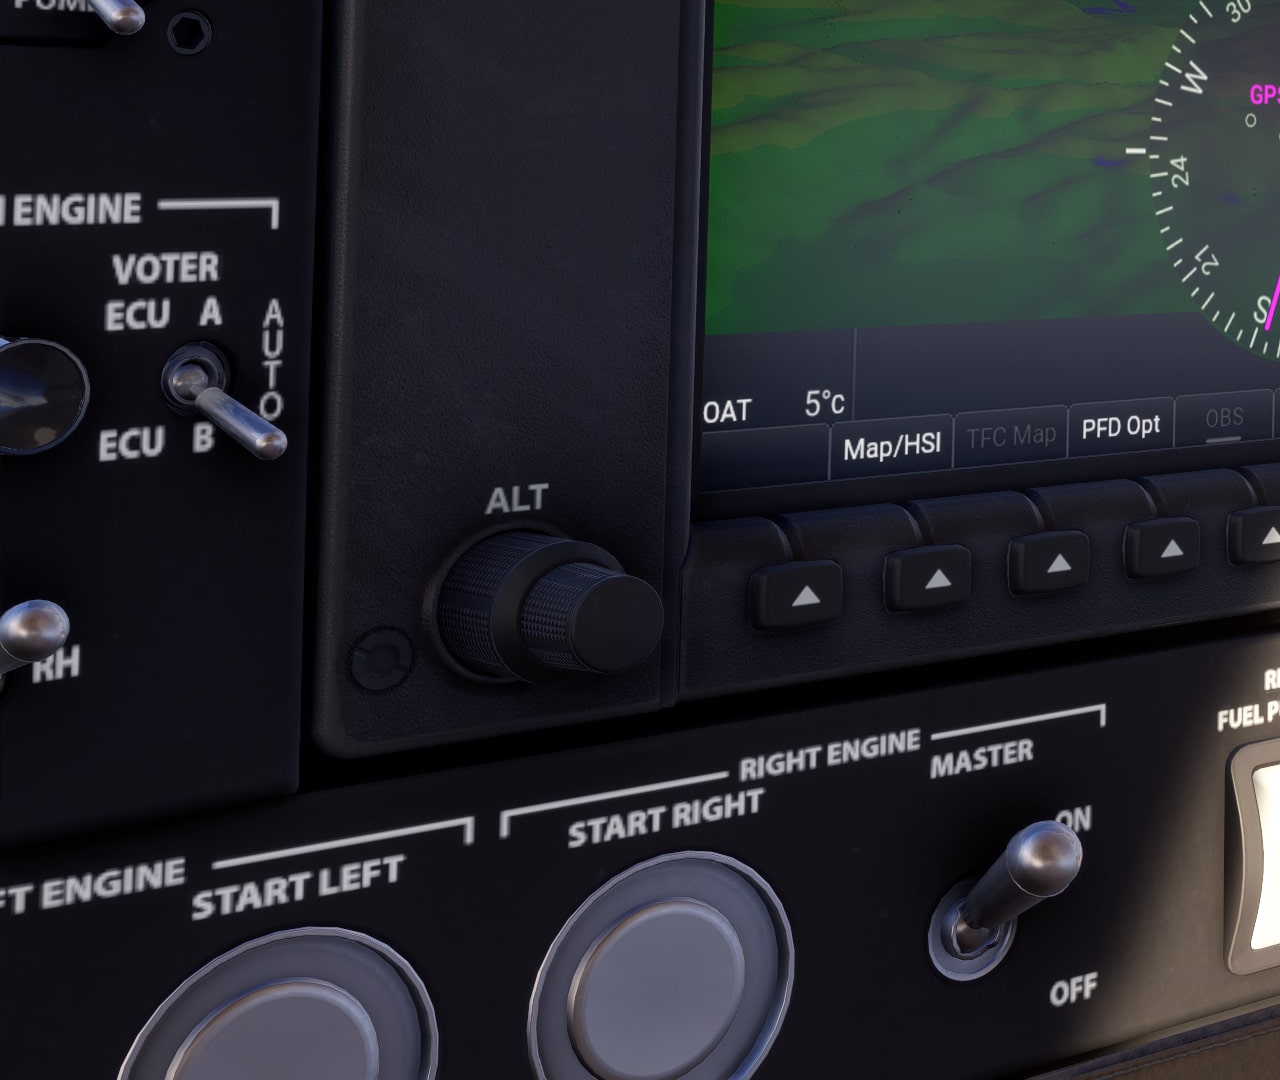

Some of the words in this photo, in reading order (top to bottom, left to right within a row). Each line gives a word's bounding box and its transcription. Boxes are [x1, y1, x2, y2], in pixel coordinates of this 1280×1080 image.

[13, 192, 142, 226] ENGINE
[112, 250, 220, 285] VOTER
[104, 298, 171, 332] ECU
[199, 296, 223, 327] A
[98, 425, 165, 461] ECU
[192, 422, 215, 454] B
[1082, 416, 1122, 439] PFD
[1126, 415, 1161, 439] Opt
[844, 432, 942, 463] Map/HSI
[485, 483, 549, 516] ALT
[1217, 704, 1264, 732] FUEL
[738, 745, 822, 783] RIGHT
[827, 727, 921, 770] ENGINE
[929, 738, 1035, 781] MASTER
[568, 806, 666, 849] START
[672, 787, 766, 831] RIGHT
[41, 856, 187, 912] ENGINE
[191, 871, 312, 921] START
[318, 854, 406, 898] LEFT
[1049, 972, 1099, 1008] OFF
